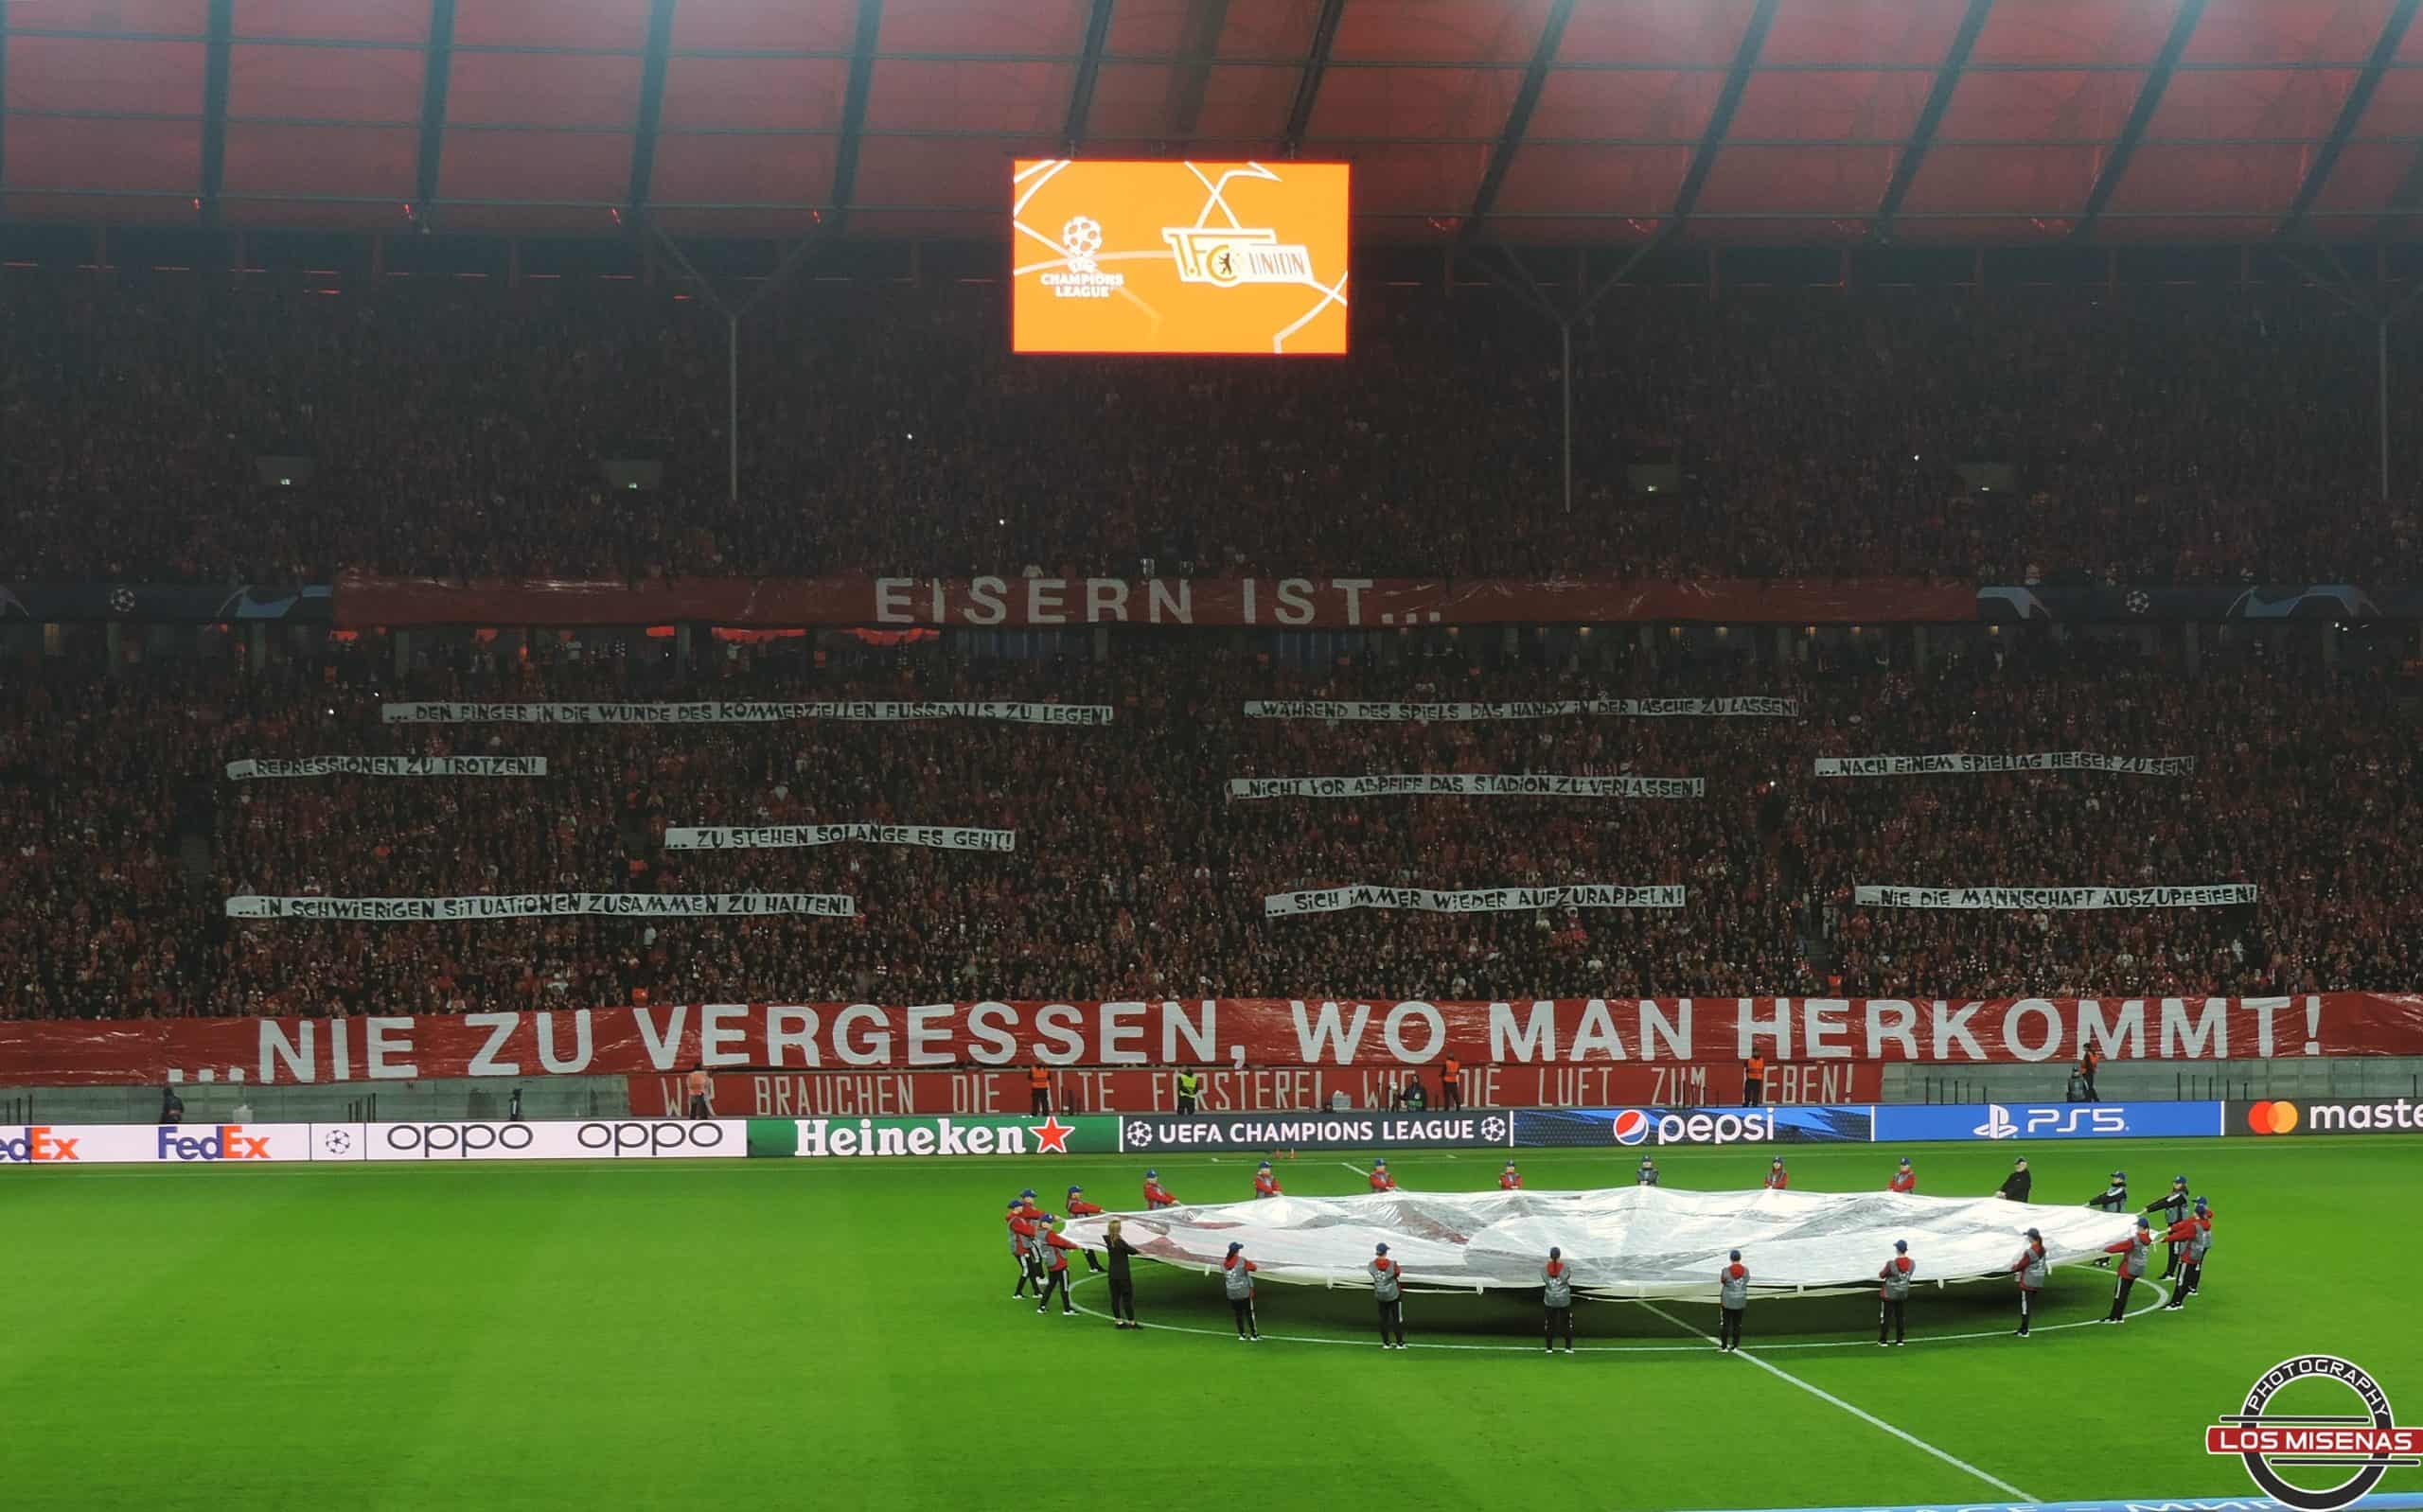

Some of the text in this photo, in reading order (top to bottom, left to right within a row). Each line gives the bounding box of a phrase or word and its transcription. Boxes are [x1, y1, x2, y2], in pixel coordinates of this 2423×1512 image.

[1040, 273, 1124, 287] CHAMPIONS
[1055, 286, 1109, 297] LEAGUE
[875, 577, 1441, 624] EISERN IST...
[598, 705, 671, 721] WUNDE
[678, 706, 712, 720] DES
[886, 703, 997, 719] FUSSBALLS
[1005, 705, 1033, 720] ZU
[1043, 706, 1111, 725] LEGEN!
[1357, 705, 1390, 719] DES
[1471, 704, 1504, 719] DAS
[1511, 703, 1567, 718] HANDY
[1597, 700, 1628, 714] DER
[1701, 698, 1725, 713] ZU
[406, 757, 433, 774] ZU
[445, 757, 536, 774] TROTZEN!
[2119, 758, 2146, 773] ZU
[1310, 780, 1345, 795] VOR
[1430, 777, 1464, 792] DAS
[1555, 779, 1584, 794] ZU
[733, 829, 807, 848] STEHEN
[918, 830, 944, 845] ES
[954, 831, 1011, 850] GEHT!
[589, 895, 719, 914] ZUSAMMEN
[727, 895, 757, 913] ZU
[766, 895, 847, 915] HALTEN!
[1518, 888, 1682, 907] AUFZURAPPELN!
[1961, 889, 2096, 908] MANNSCHAFT
[168, 996, 2321, 1082] ...NIE ZU VERGESSEN, WO MAN HERKOMMT!
[661, 1075, 716, 1117] WR
[753, 1074, 913, 1116] BRAUCHEN
[952, 1073, 1000, 1114] DIE
[1039, 1071, 1115, 1113] LTE
[1152, 1070, 1322, 1112] FRSTEREI
[1538, 1066, 1613, 1107] LUFT
[1651, 1065, 1706, 1106] ZUM
[1742, 1064, 1854, 1106] EBEN!
[1158, 1119, 1475, 1144] UEFA CHAMPIONS LEAGUE
[1658, 1108, 1775, 1145] pepsi
[2027, 1107, 2126, 1134] PS5
[158, 1125, 272, 1160] FedEx
[387, 1123, 533, 1158] oppo
[577, 1121, 723, 1157] oppo
[794, 1117, 1027, 1156] Heineken
